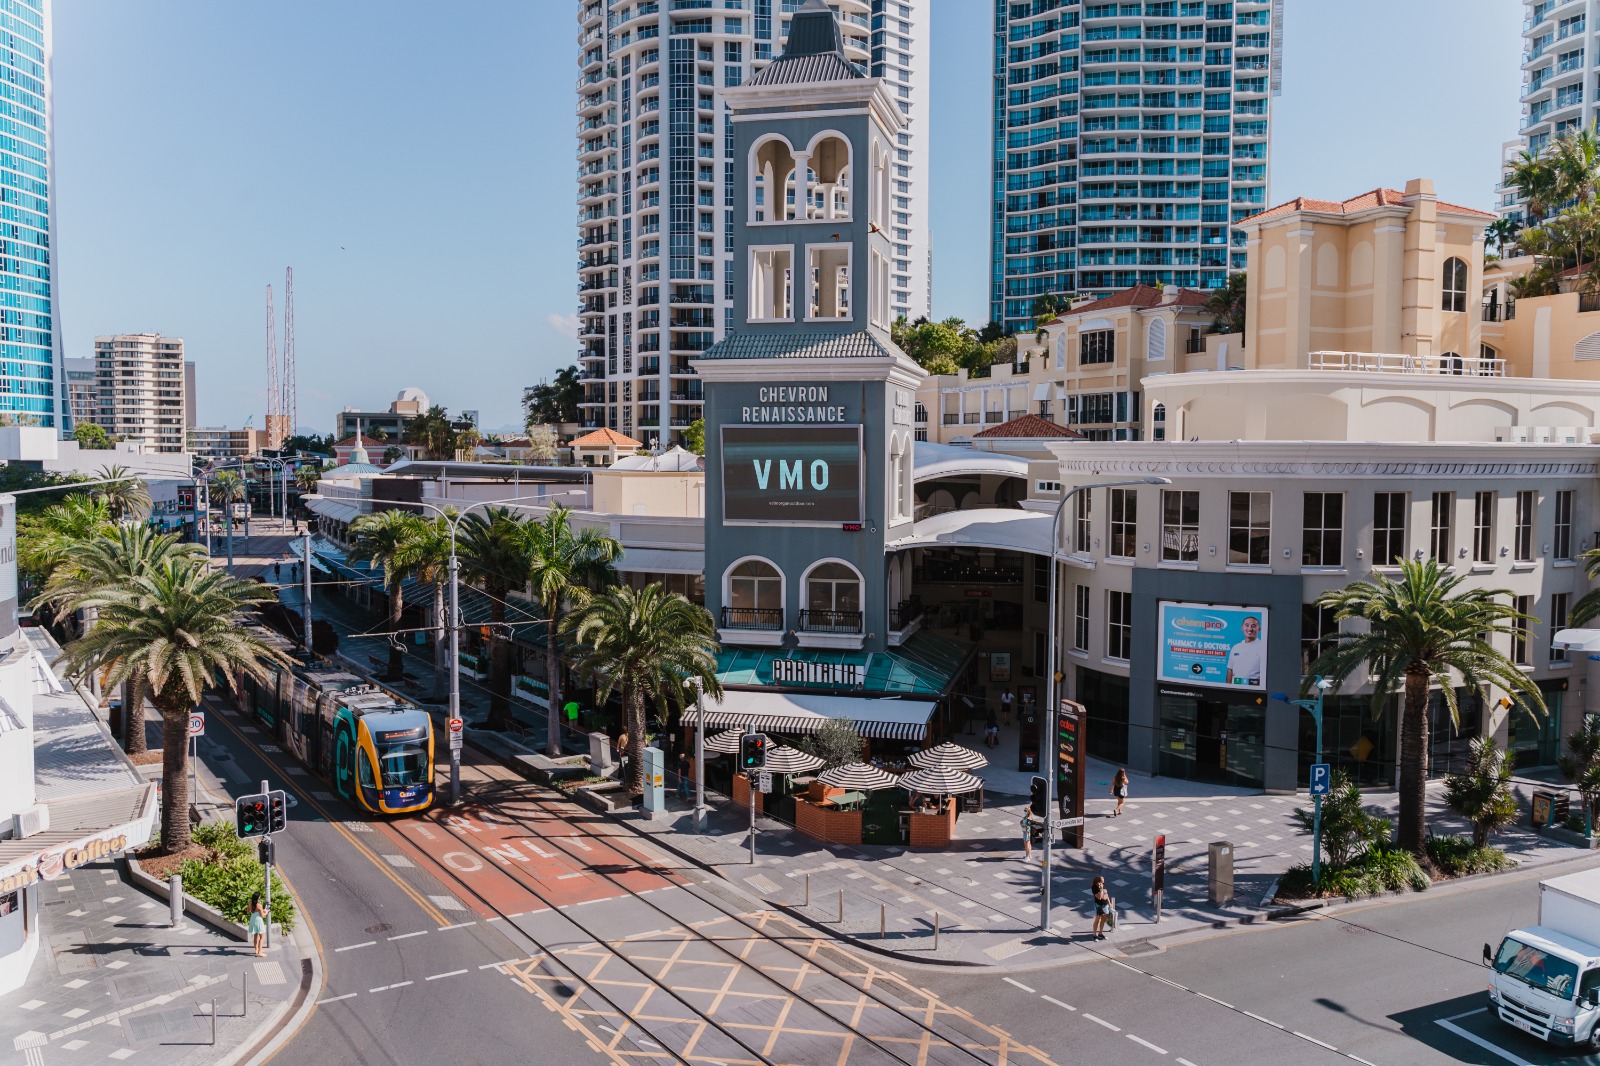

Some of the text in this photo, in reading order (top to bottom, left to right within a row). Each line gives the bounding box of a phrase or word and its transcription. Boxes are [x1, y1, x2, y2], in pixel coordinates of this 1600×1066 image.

[759, 386, 828, 402] CHEVRON
[742, 406, 845, 422] RENAISSANCE
[753, 459, 829, 490] VMO
[1167, 639, 1197, 648] PHARMACY
[1204, 642, 1231, 651] DOCTORS
[1060, 719, 1075, 731] coles
[1315, 768, 1325, 781] P
[64, 834, 127, 869] Coffees
[443, 832, 593, 872] ONLY
